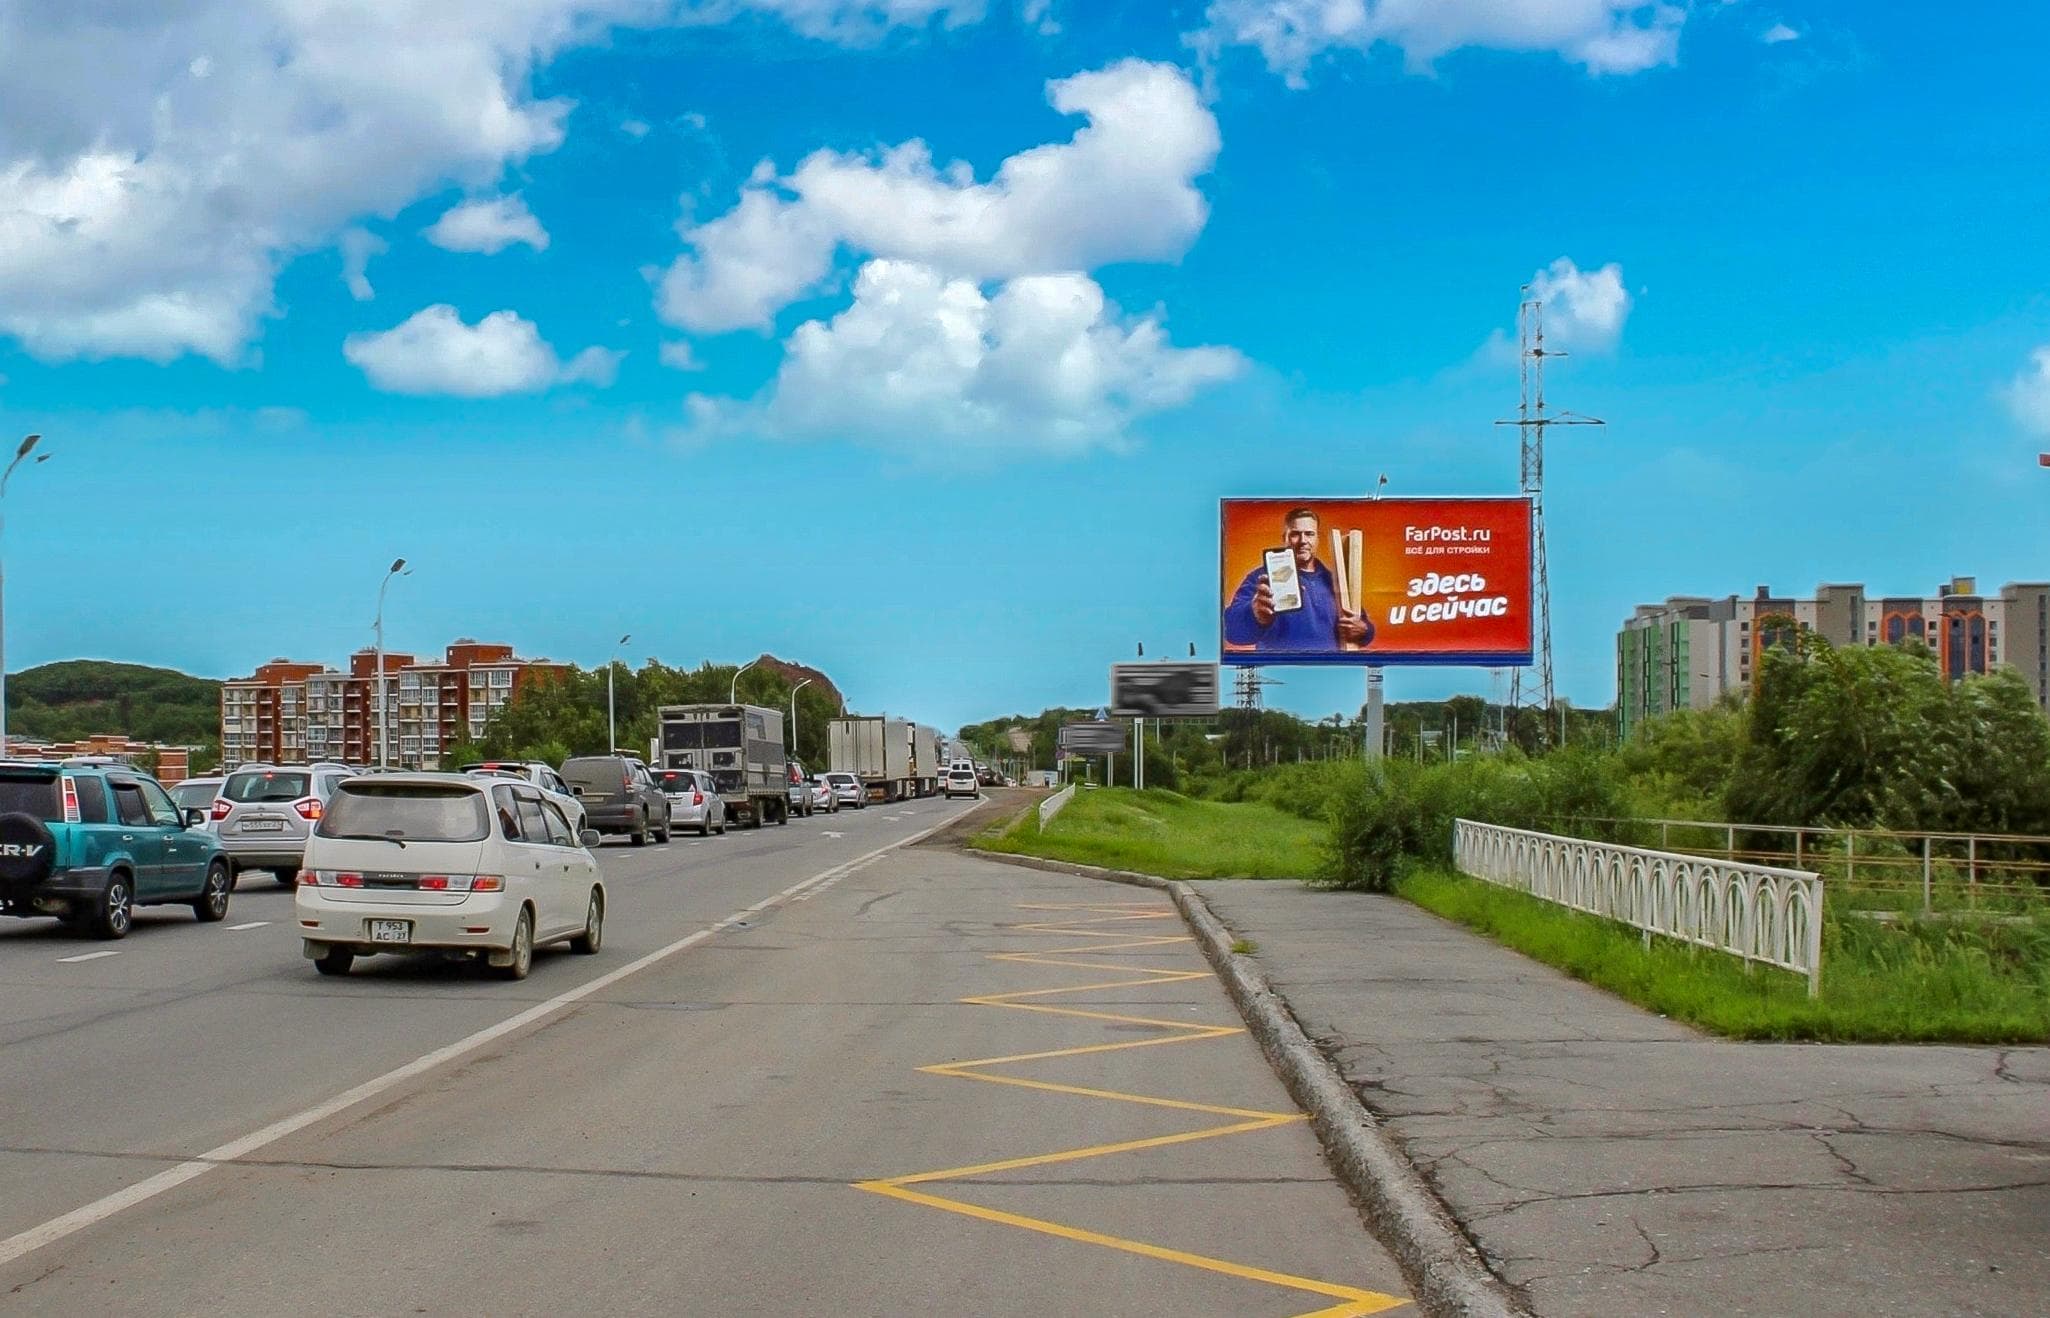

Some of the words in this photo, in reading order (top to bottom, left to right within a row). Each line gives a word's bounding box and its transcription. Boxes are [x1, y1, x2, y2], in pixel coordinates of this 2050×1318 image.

[1405, 526, 1491, 541] FarPost.ru
[1425, 546, 1444, 555] ДЛЯ
[1446, 545, 1490, 555] СТРОЙКИ
[1407, 572, 1486, 597] здесь
[1389, 605, 1407, 624] и
[1411, 595, 1508, 623] сейчас
